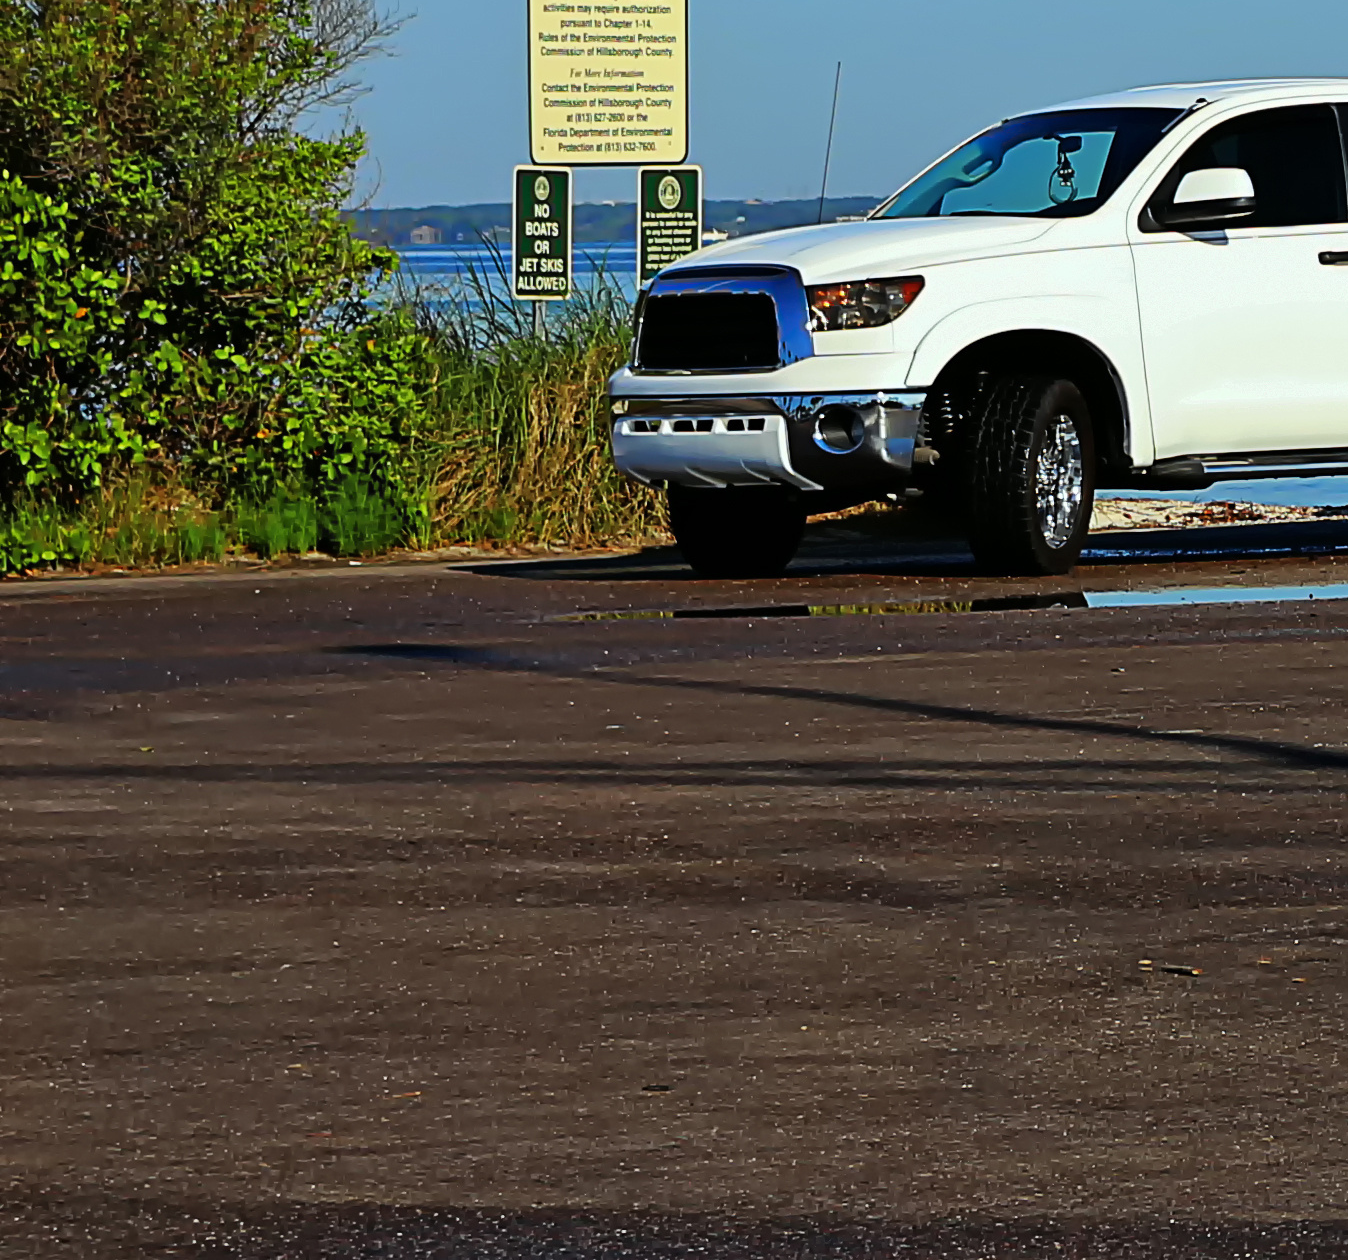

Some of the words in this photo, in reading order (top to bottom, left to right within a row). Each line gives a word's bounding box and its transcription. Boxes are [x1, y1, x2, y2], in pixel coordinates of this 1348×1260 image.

[543, 4, 575, 12] activities
[577, 6, 591, 15] may
[594, 6, 619, 14] require
[622, 5, 671, 14] authorization
[561, 20, 592, 28] pursuant
[594, 20, 601, 28] to
[604, 18, 632, 29] Chapter
[539, 32, 558, 42] Rules
[561, 34, 568, 42] of
[570, 34, 581, 42] the
[583, 33, 635, 42] Environmental
[638, 34, 676, 43] Protection
[541, 46, 585, 56] Commission
[587, 47, 594, 56] of
[596, 47, 643, 58] Hillsborough
[570, 68, 581, 77] For
[585, 69, 601, 77] More
[604, 69, 644, 78] Information
[542, 83, 569, 92] Contact
[571, 84, 581, 92] the
[584, 83, 634, 92] Environmental
[636, 83, 674, 92] Protection
[544, 98, 587, 107] Commission
[589, 98, 596, 107] of
[598, 99, 643, 109] Hillsborough
[646, 98, 671, 109] County
[567, 114, 573, 122] at
[575, 113, 592, 123] (813)
[637, 113, 648, 121] the
[543, 128, 567, 137] Florida
[570, 128, 610, 138] Department
[612, 128, 619, 136] of
[621, 127, 672, 137] Environmental
[558, 143, 594, 152] Protection
[596, 144, 602, 152] at
[605, 142, 621, 152] (813)
[535, 204, 549, 218] NO
[526, 222, 558, 236] BOATS
[534, 240, 549, 254] OR
[520, 258, 538, 272] JET
[540, 258, 563, 272] SKIS
[518, 276, 566, 290] ALLOWED
